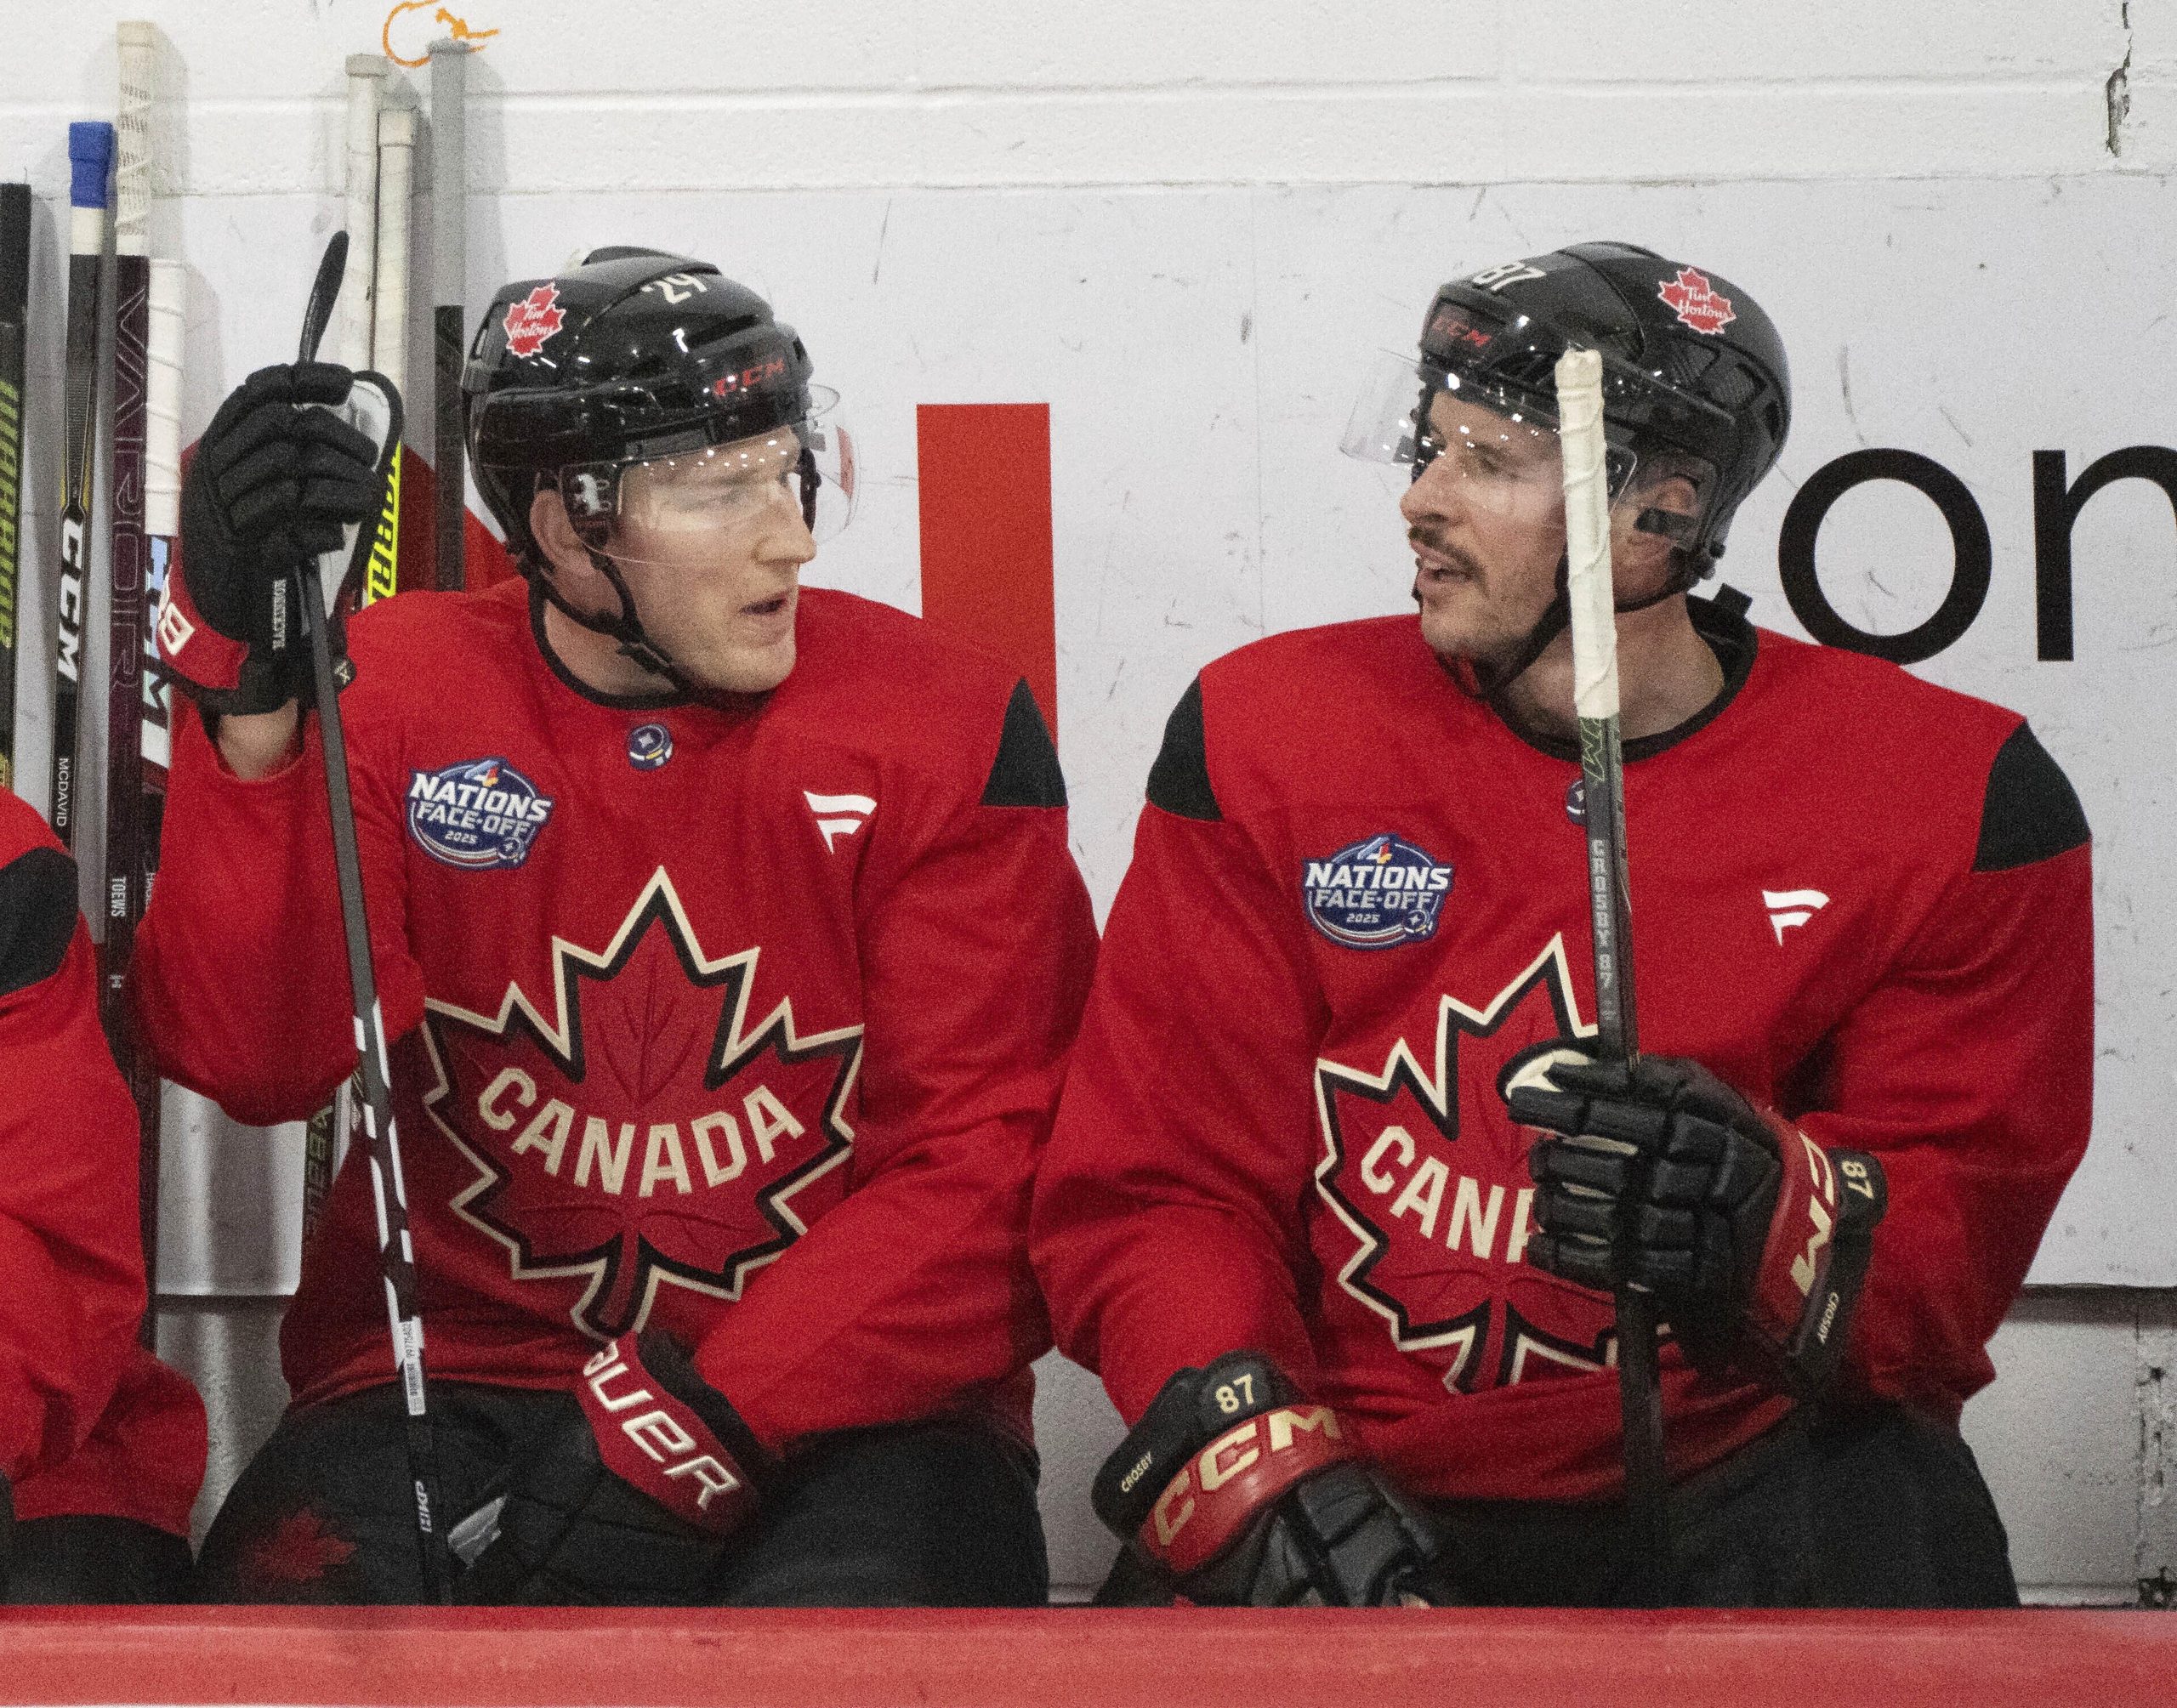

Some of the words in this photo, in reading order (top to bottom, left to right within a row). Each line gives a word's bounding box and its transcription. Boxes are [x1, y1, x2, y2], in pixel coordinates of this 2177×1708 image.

[525, 303, 547, 321] Tim
[1679, 299, 1729, 319] Hortons
[1686, 287, 1708, 301] Tim
[512, 322, 553, 338] Hortons
[713, 357, 786, 398] CCM
[57, 516, 85, 682] CCM
[55, 758, 69, 826] MCDAVID
[409, 772, 552, 823] NATIONS
[416, 800, 531, 838] FACE-OFF
[1305, 862, 1452, 890] NATIONS
[111, 877, 127, 917] TOEWS
[1314, 889, 1434, 910] FACE-OFF
[477, 1067, 806, 1198] CANADA
[1840, 1160, 1875, 1200] 87
[1789, 1129, 1835, 1297] CM
[1816, 1291, 1839, 1345] CROSBY
[1215, 1373, 1254, 1414] 87
[1120, 1450, 1154, 1493] CROSBY
[1154, 1405, 1343, 1546] CCM
